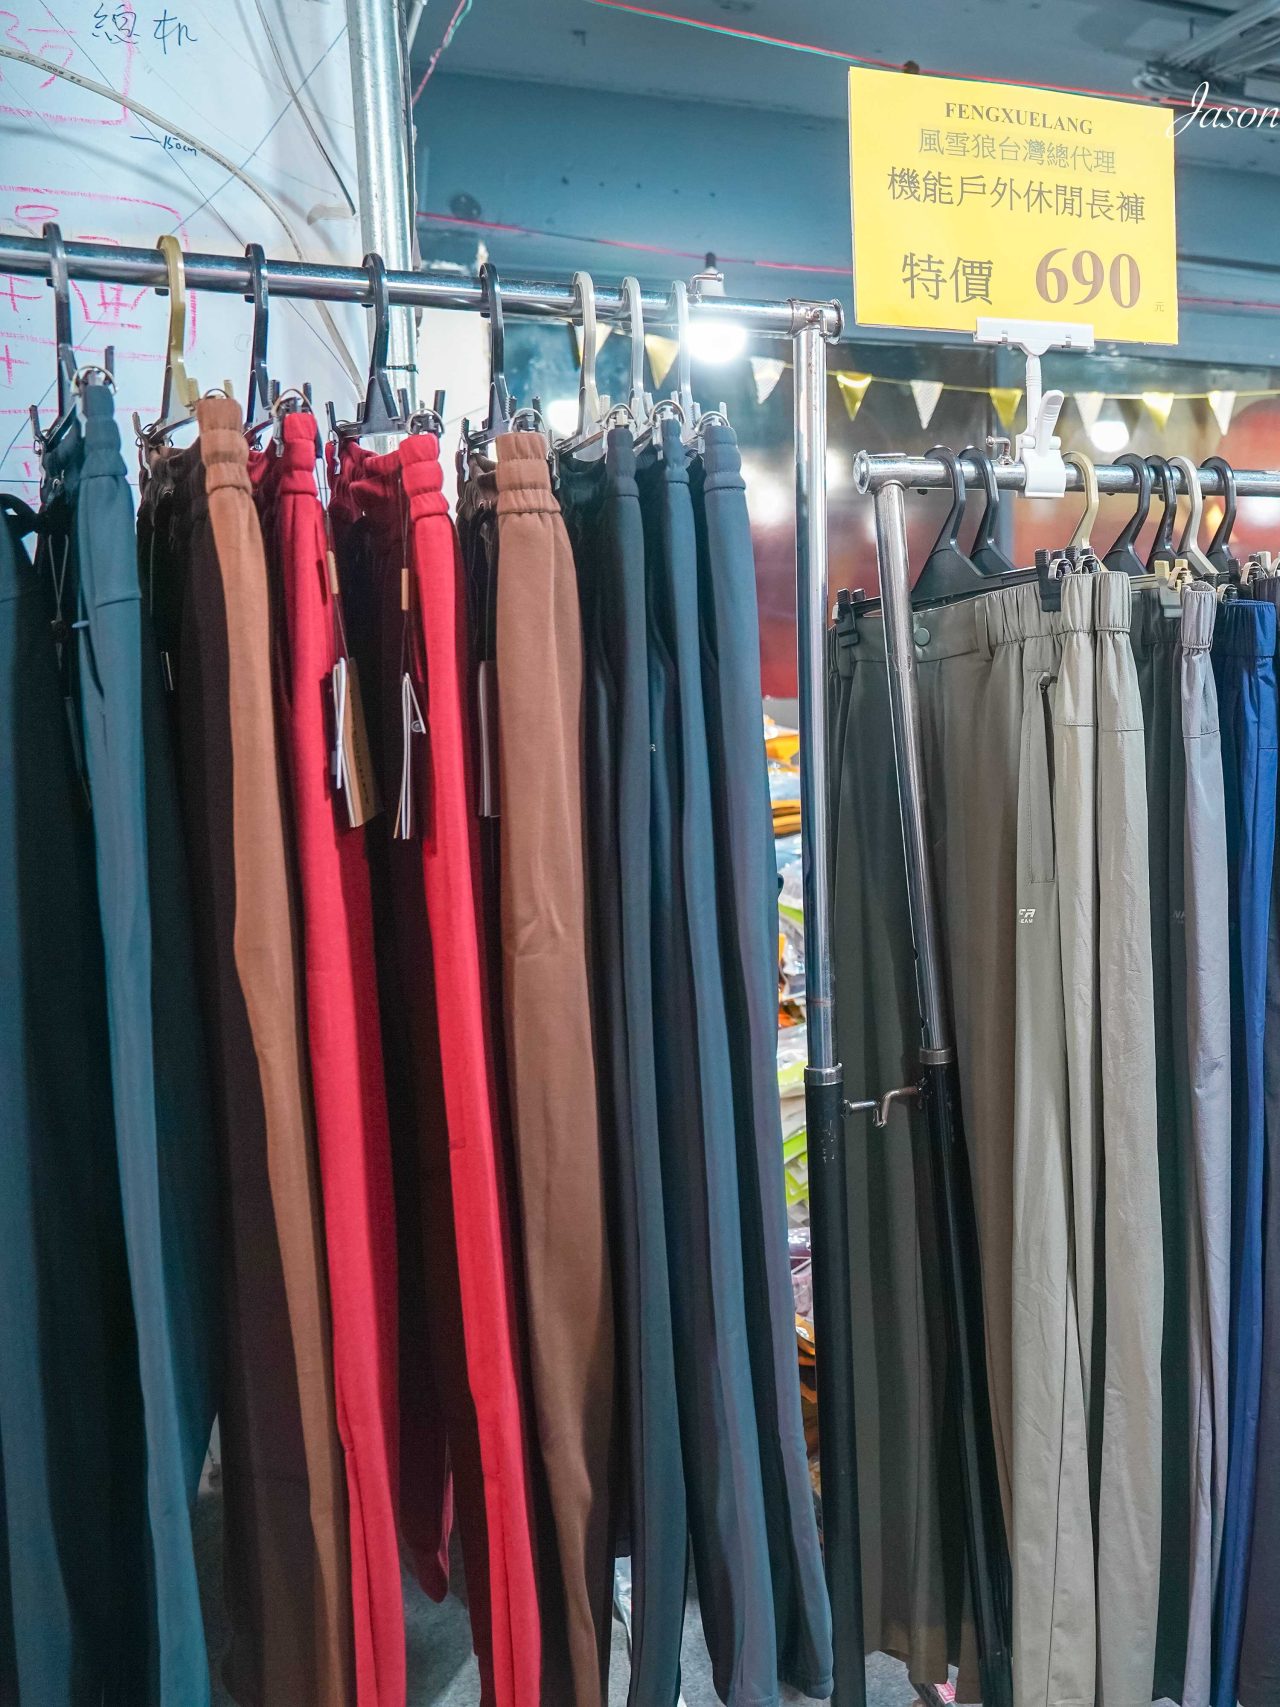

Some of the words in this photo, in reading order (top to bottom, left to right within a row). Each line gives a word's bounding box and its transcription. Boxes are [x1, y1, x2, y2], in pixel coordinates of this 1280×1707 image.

[945, 102, 1093, 135] FENGXUELANG
[918, 128, 1116, 175] 風雪狼台灣總代理
[887, 166, 1146, 225] 機能戶外休閒長褲
[901, 252, 994, 306] 特價
[1035, 248, 1141, 309] 690
